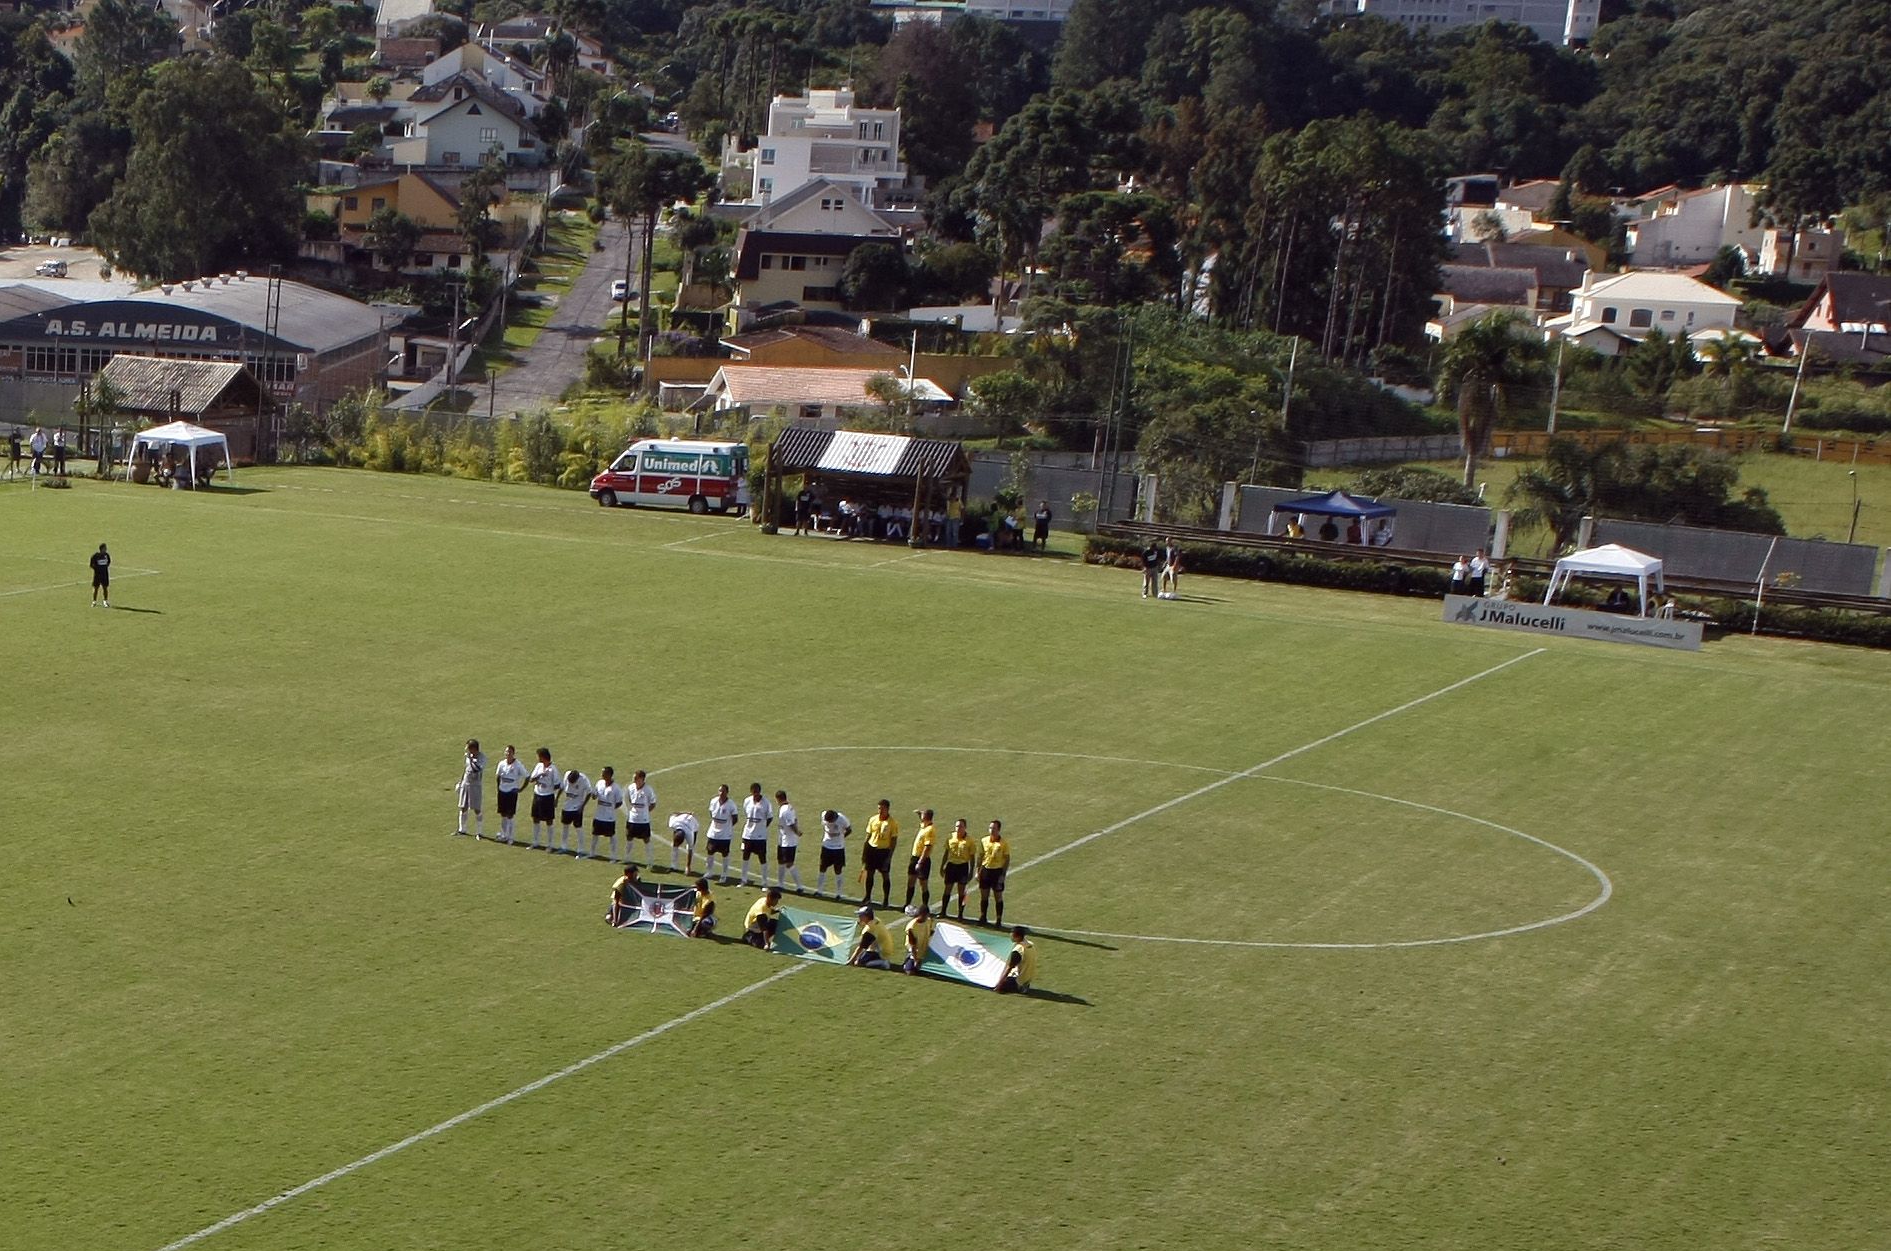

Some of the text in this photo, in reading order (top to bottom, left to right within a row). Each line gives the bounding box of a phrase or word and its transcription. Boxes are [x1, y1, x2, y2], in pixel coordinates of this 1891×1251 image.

[45, 320, 217, 341] A.S. ALMEIDA
[644, 457, 698, 471] Unimed
[657, 477, 682, 494] SOS
